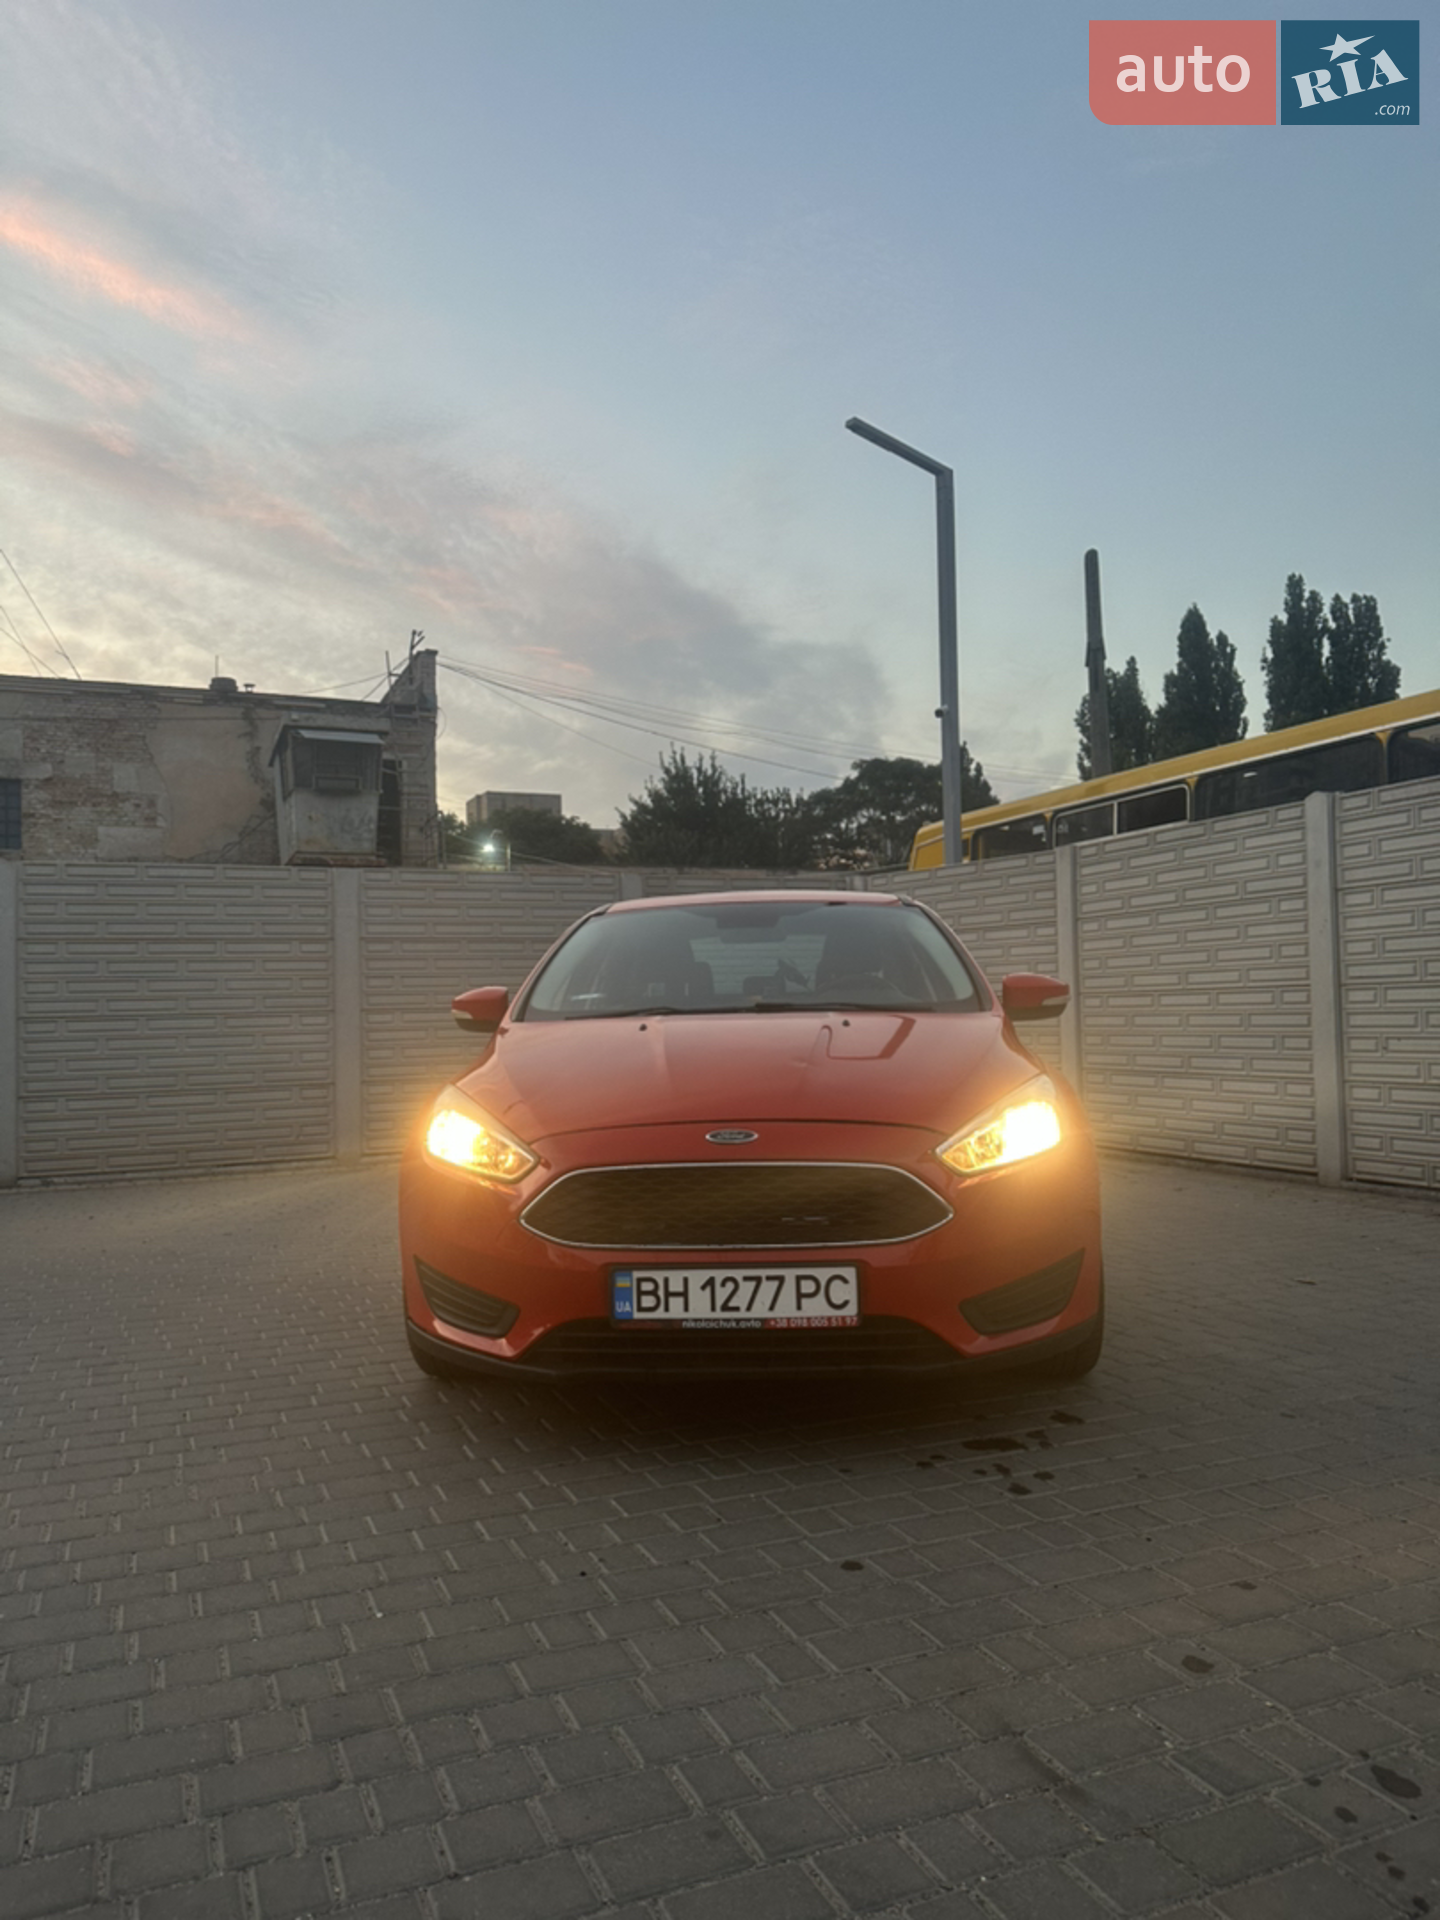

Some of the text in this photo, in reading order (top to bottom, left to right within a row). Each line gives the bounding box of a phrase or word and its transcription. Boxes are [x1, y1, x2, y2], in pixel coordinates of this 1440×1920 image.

[635, 1274, 850, 1313] BH 1277 PC
[616, 1302, 632, 1313] UA
